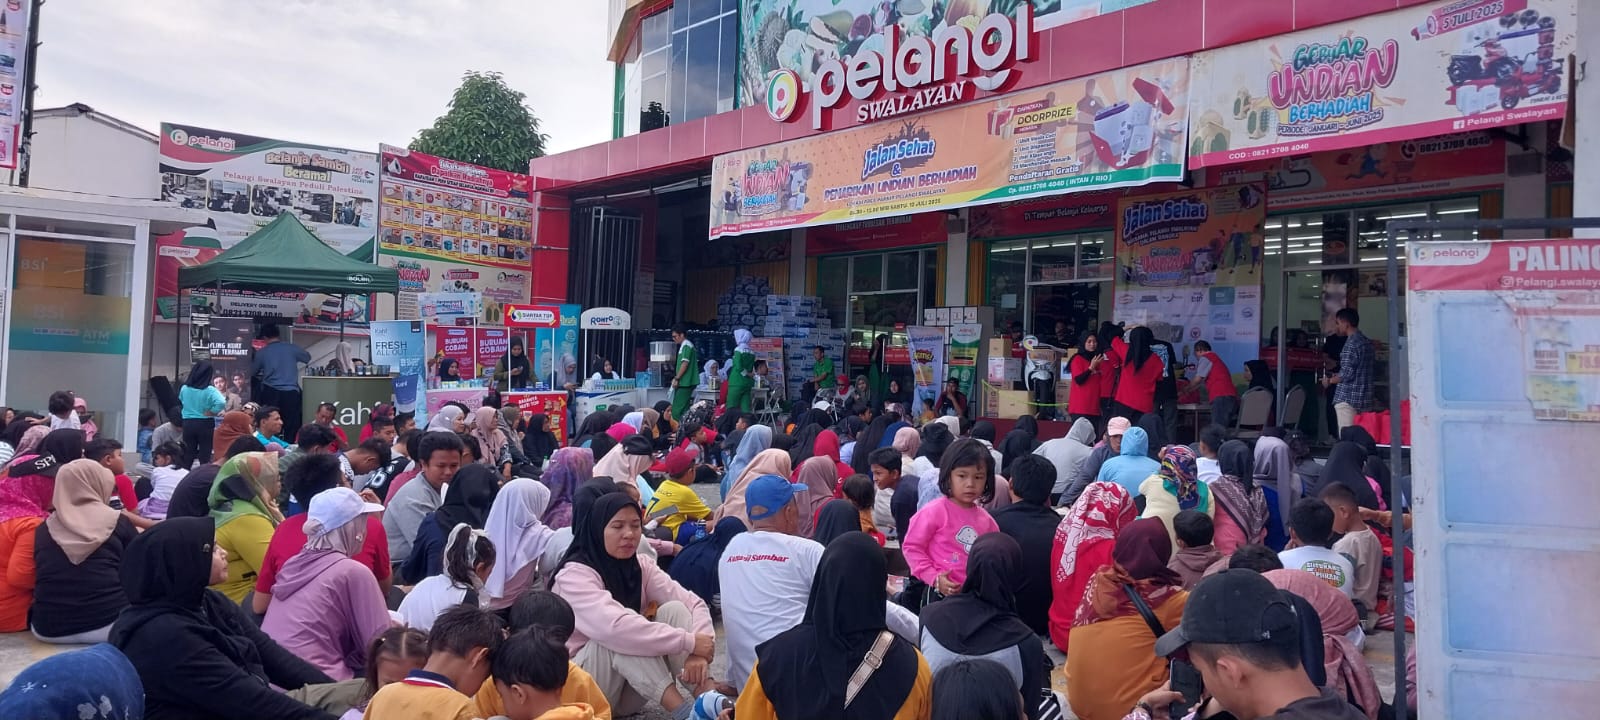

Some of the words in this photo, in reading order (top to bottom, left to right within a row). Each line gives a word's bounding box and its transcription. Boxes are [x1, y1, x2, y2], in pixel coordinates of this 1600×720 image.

[1443, 17, 1450, 29] 5
[1451, 10, 1475, 27] JULI
[1475, 2, 1503, 19] 2025
[803, 3, 1029, 129] pelangi
[857, 80, 966, 122] SWALAYAN
[1017, 107, 1072, 125] DOORPRIZE
[1277, 125, 1304, 135] PERIODE
[1308, 122, 1339, 133] JANUARI
[1345, 118, 1362, 129] JUNI
[1364, 111, 1382, 122] 2025
[1467, 116, 1504, 127] Pelangi
[1506, 107, 1557, 121] Swalayan
[188, 135, 235, 150] pelangi
[1229, 152, 1246, 160] COD
[1252, 149, 1269, 157] 0821
[1291, 143, 1309, 151] 4040
[266, 152, 310, 166] Belanja
[312, 154, 349, 173] Sambil
[863, 145, 896, 177] Jalan
[897, 138, 935, 160] Sehat
[284, 167, 331, 182] Beramal
[891, 163, 902, 176] &
[1009, 169, 1054, 183] Pendaftaran
[1056, 164, 1079, 175] Gratis
[224, 171, 252, 183] Pelangi
[257, 176, 297, 187] Swalayan
[299, 181, 325, 191] Peduli
[327, 184, 364, 195] Palestina
[823, 182, 875, 202] PENARIKAN
[878, 176, 915, 194] UNDIAN
[918, 166, 977, 187] BERHADIAH
[1069, 177, 1089, 185] INTAN
[1095, 174, 1108, 182] RIO
[1123, 203, 1162, 238] Jalan
[1163, 198, 1207, 219] Sehat
[1433, 248, 1479, 259] pelangi
[1516, 277, 1600, 288] Pelangi.swalay
[375, 341, 408, 350] FRESH
